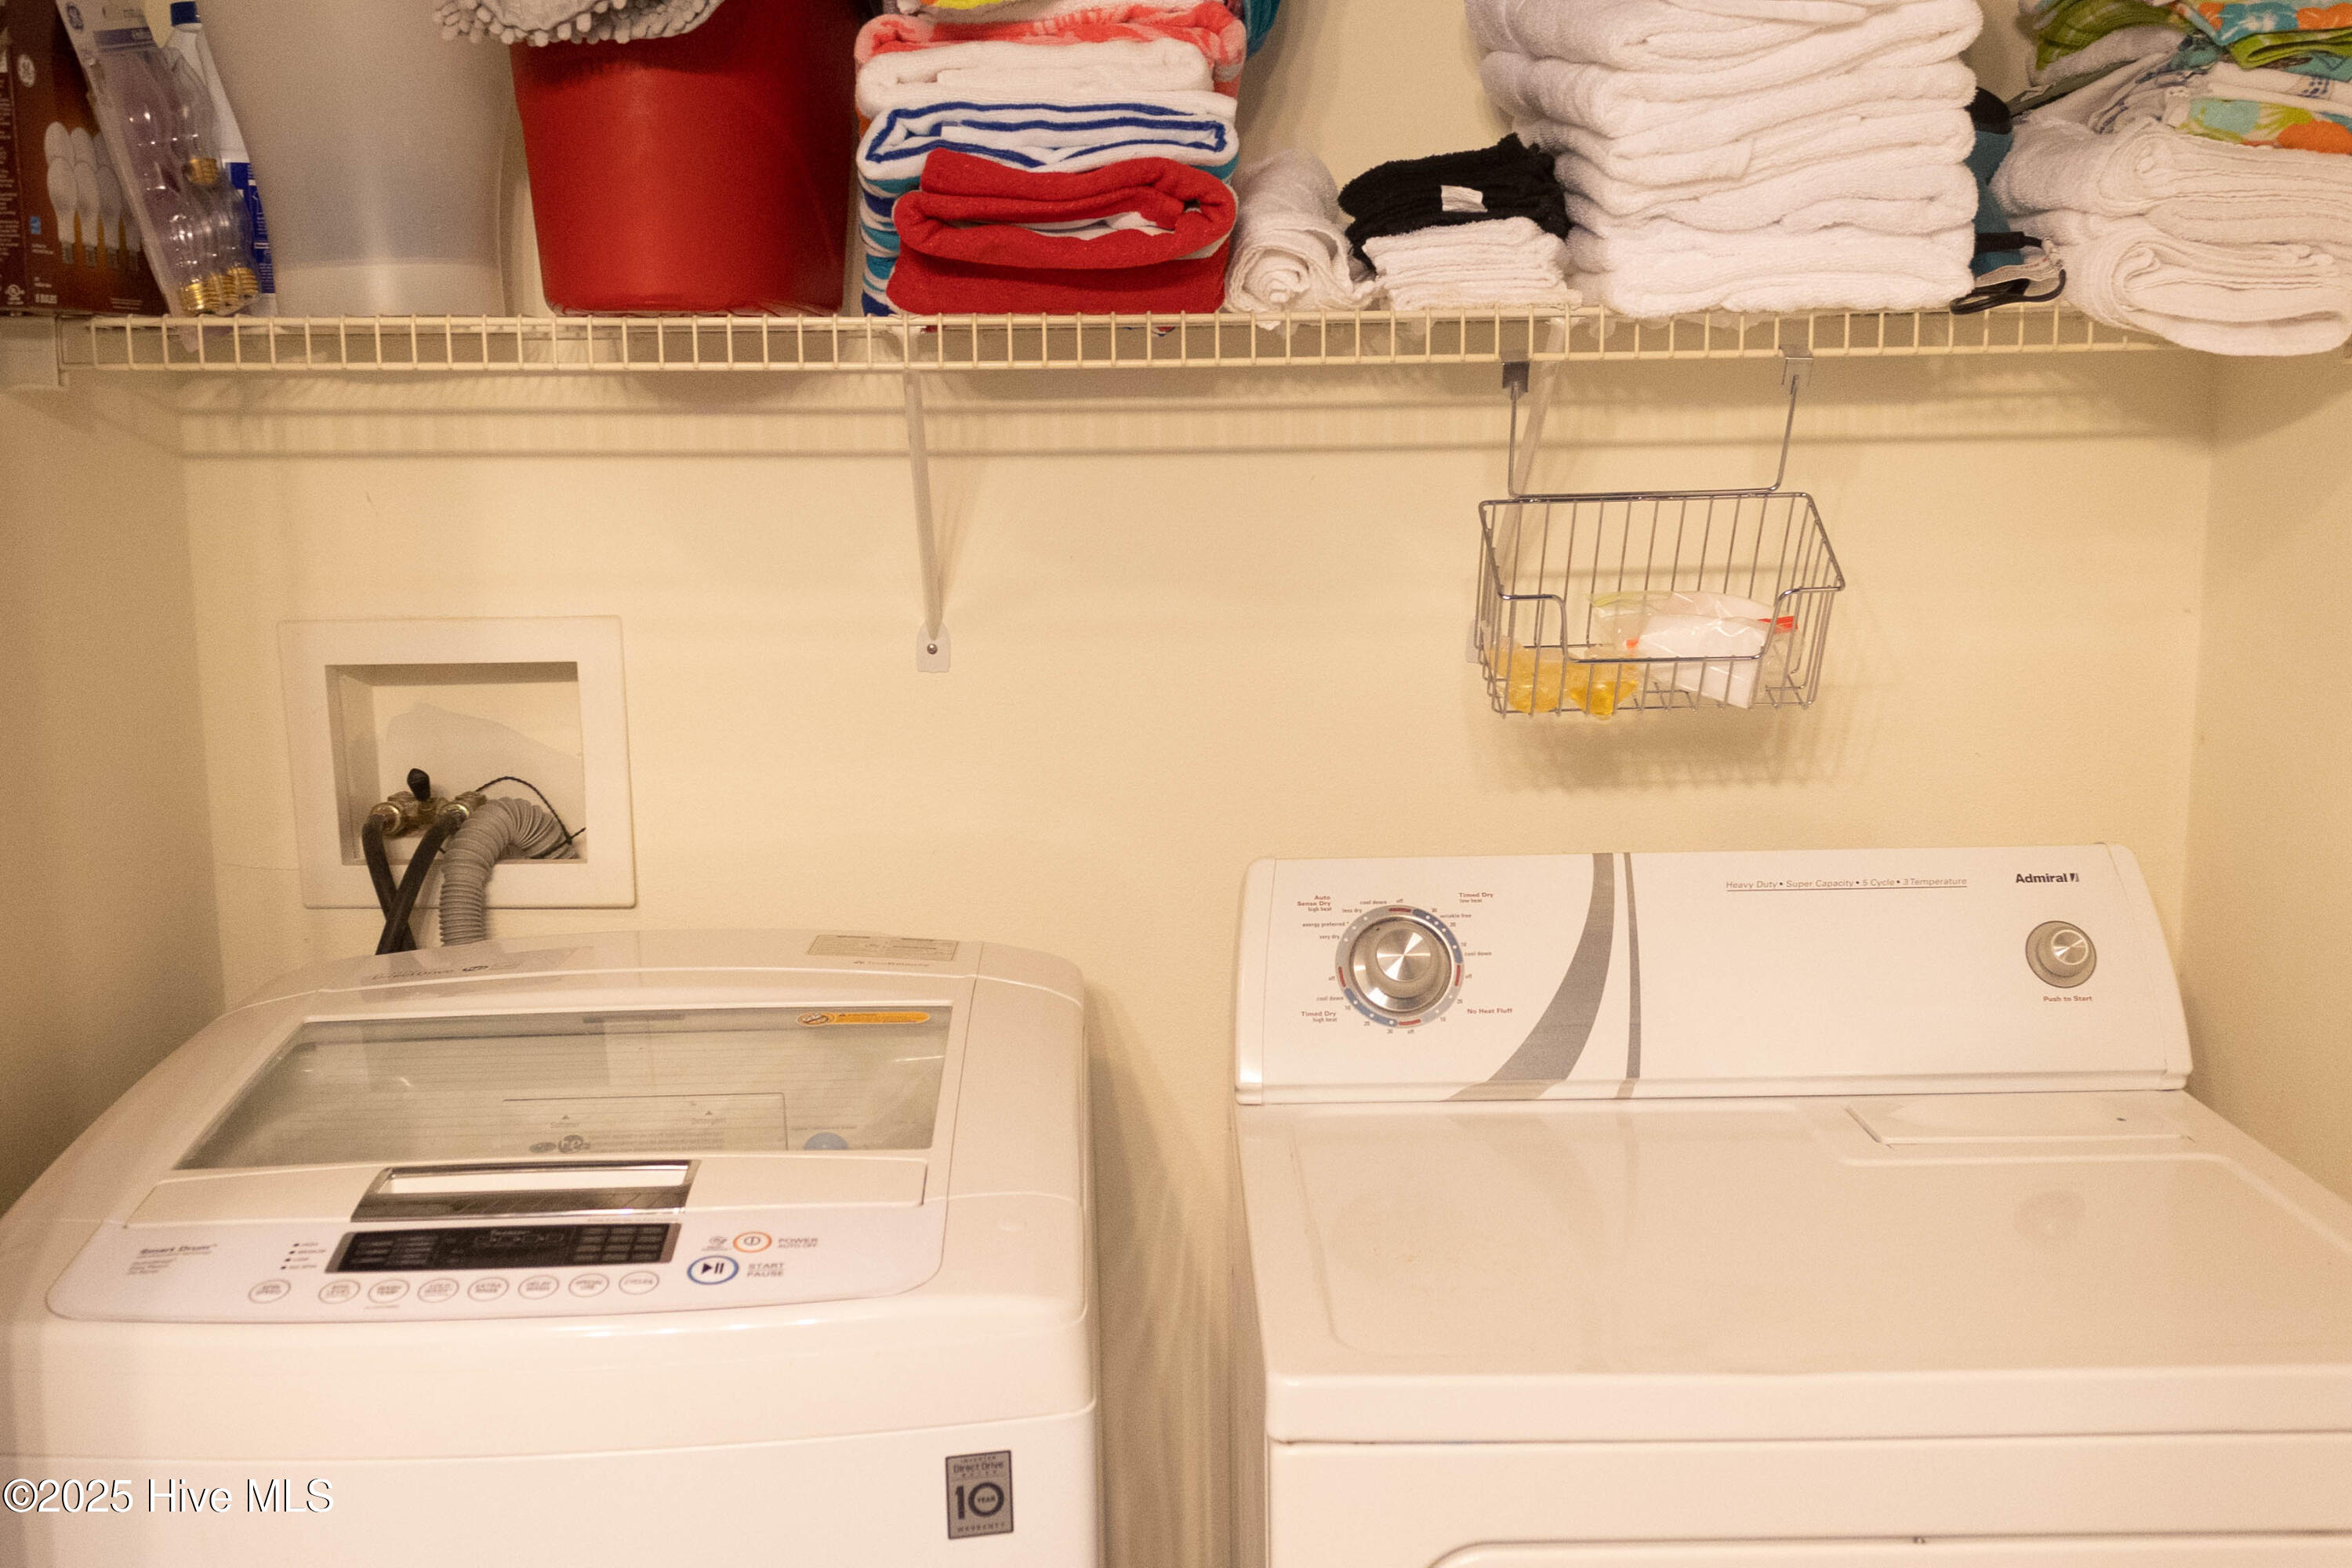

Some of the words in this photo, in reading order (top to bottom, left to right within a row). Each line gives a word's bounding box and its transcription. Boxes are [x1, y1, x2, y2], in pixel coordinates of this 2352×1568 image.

[1756, 880, 1777, 888] Duty
[1815, 879, 1854, 887] Capacity
[1870, 878, 1895, 887] Cycle
[1911, 877, 1968, 886] Temperature
[2016, 873, 2068, 883] Admiral
[953, 1462, 980, 1474] Direct
[981, 1461, 1004, 1471] Drive
[955, 1482, 1005, 1520] 10
[977, 1494, 996, 1504] YEAR
